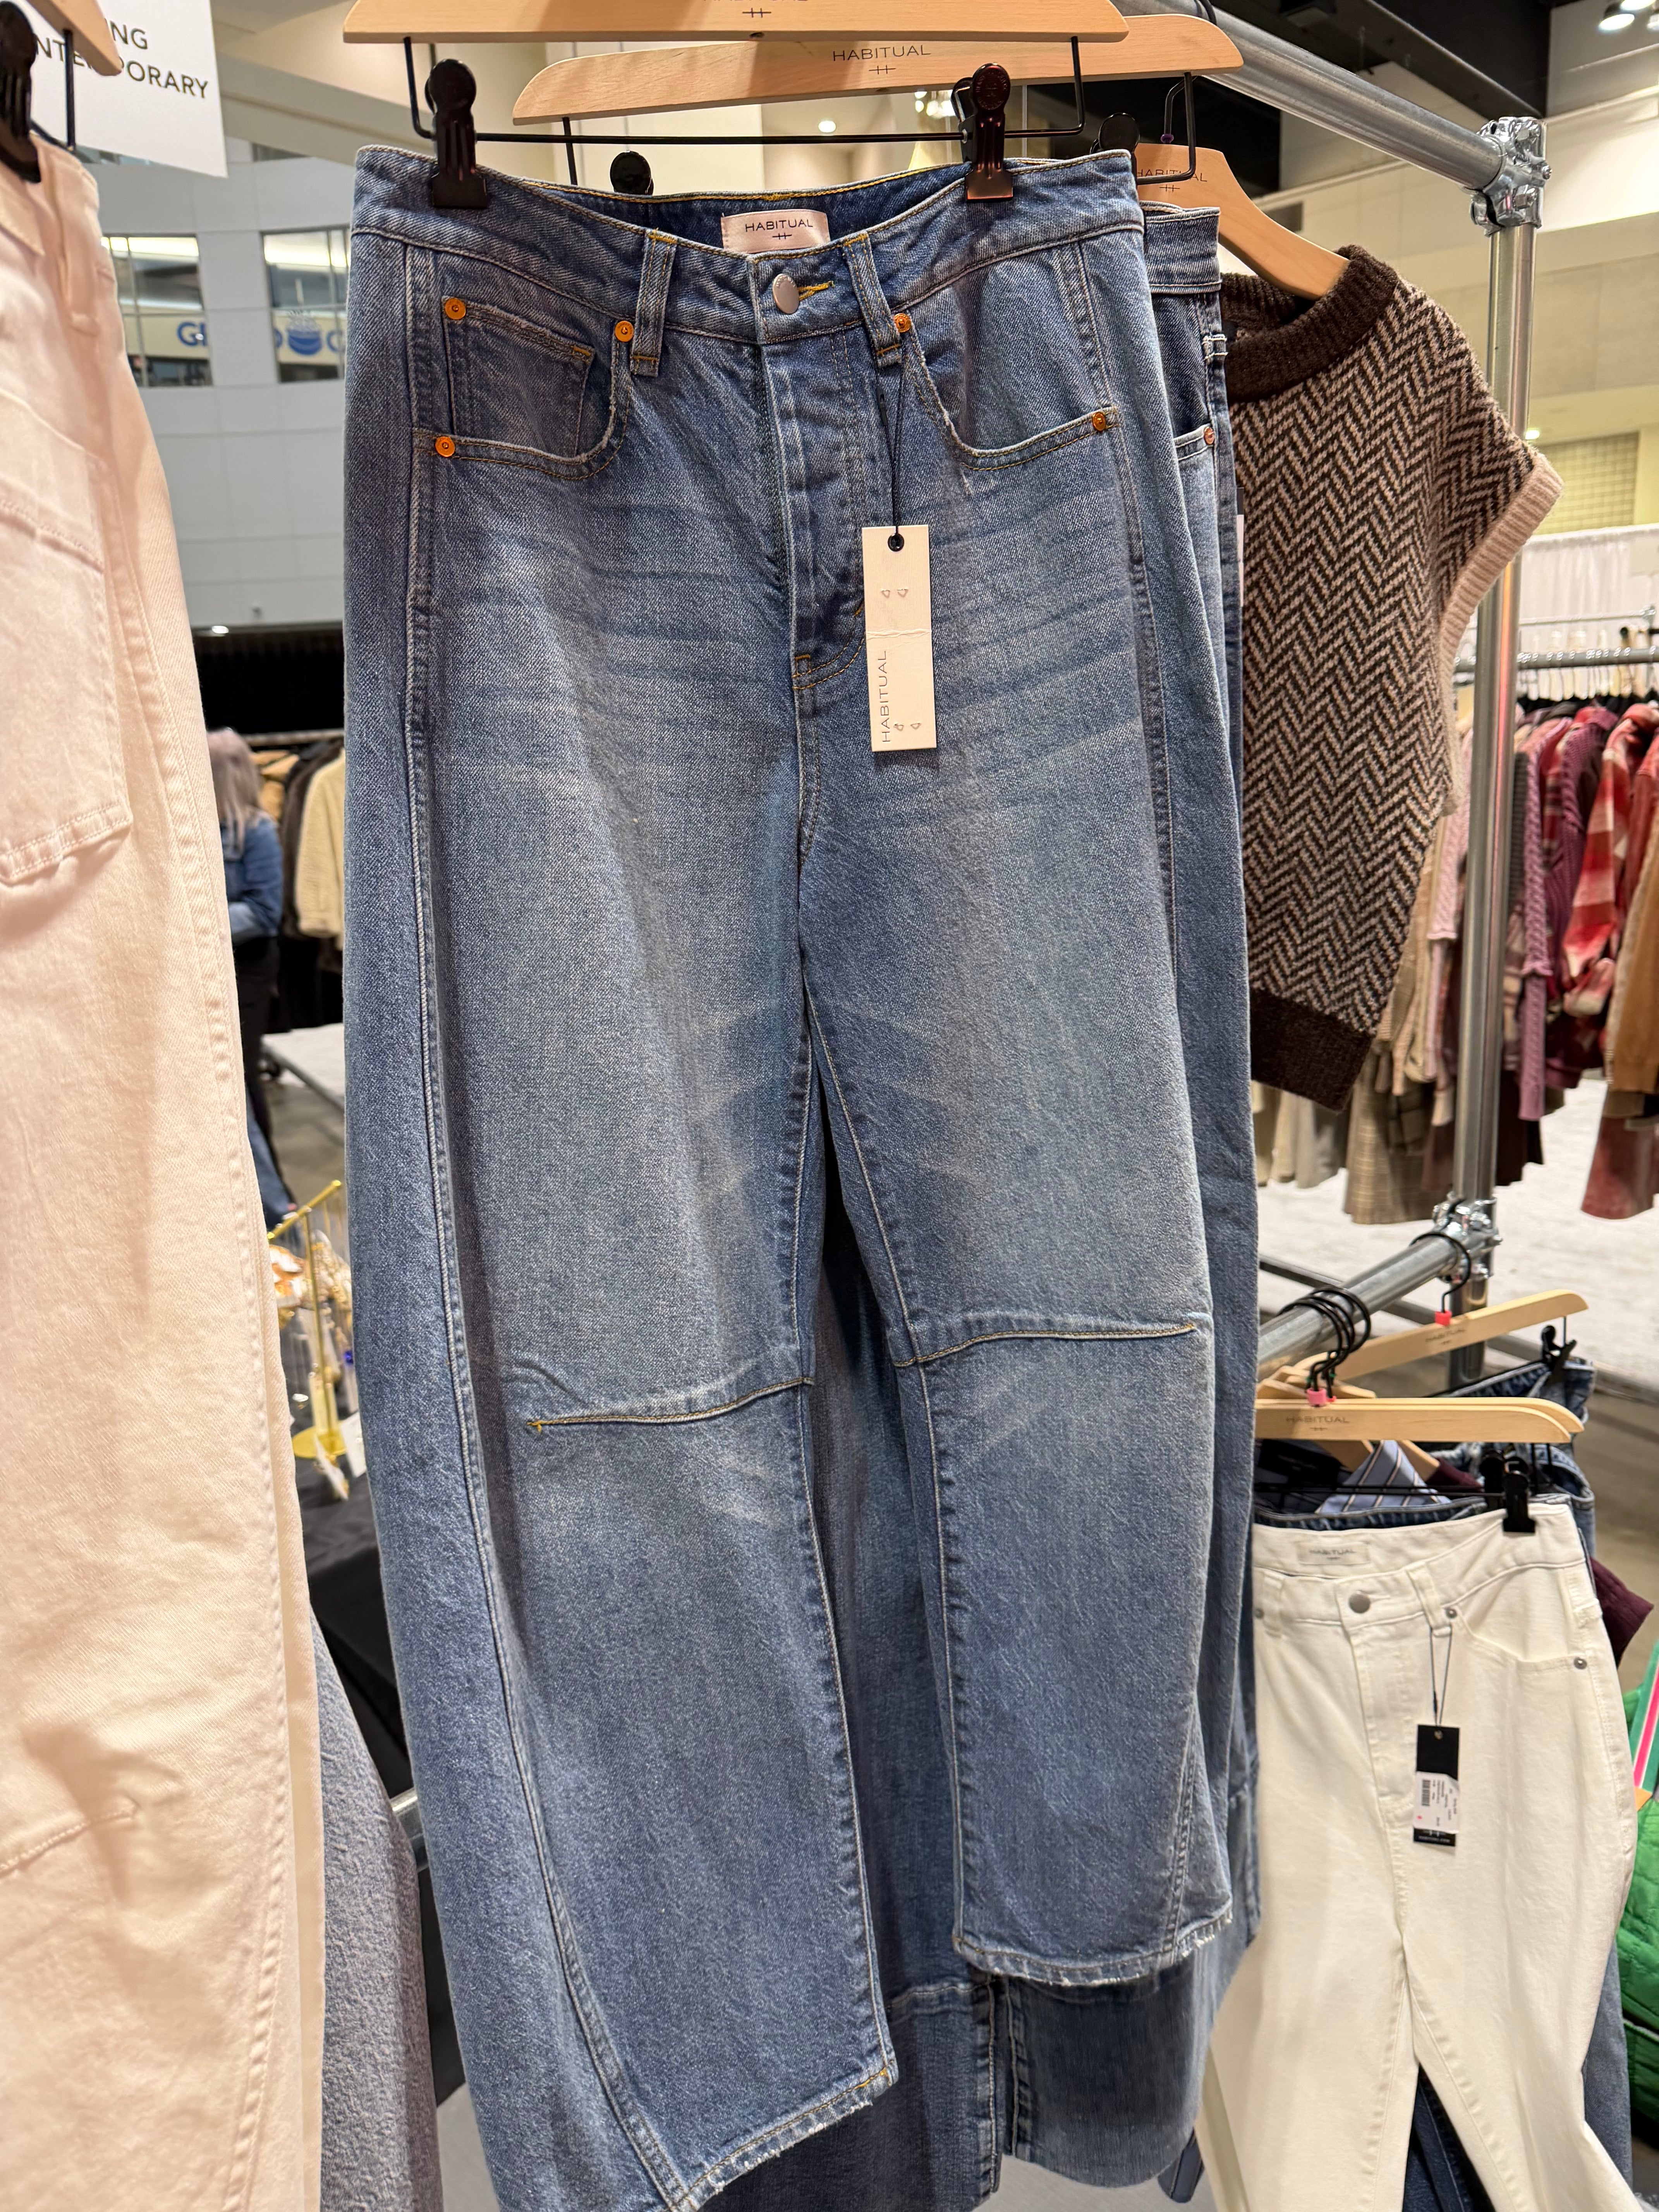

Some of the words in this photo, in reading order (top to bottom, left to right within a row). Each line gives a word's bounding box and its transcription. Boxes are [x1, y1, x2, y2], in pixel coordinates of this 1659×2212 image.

[833, 45, 931, 62] HABITUAL
[745, 219, 813, 232] HABITUAL
[878, 650, 891, 743] HABITUAL
